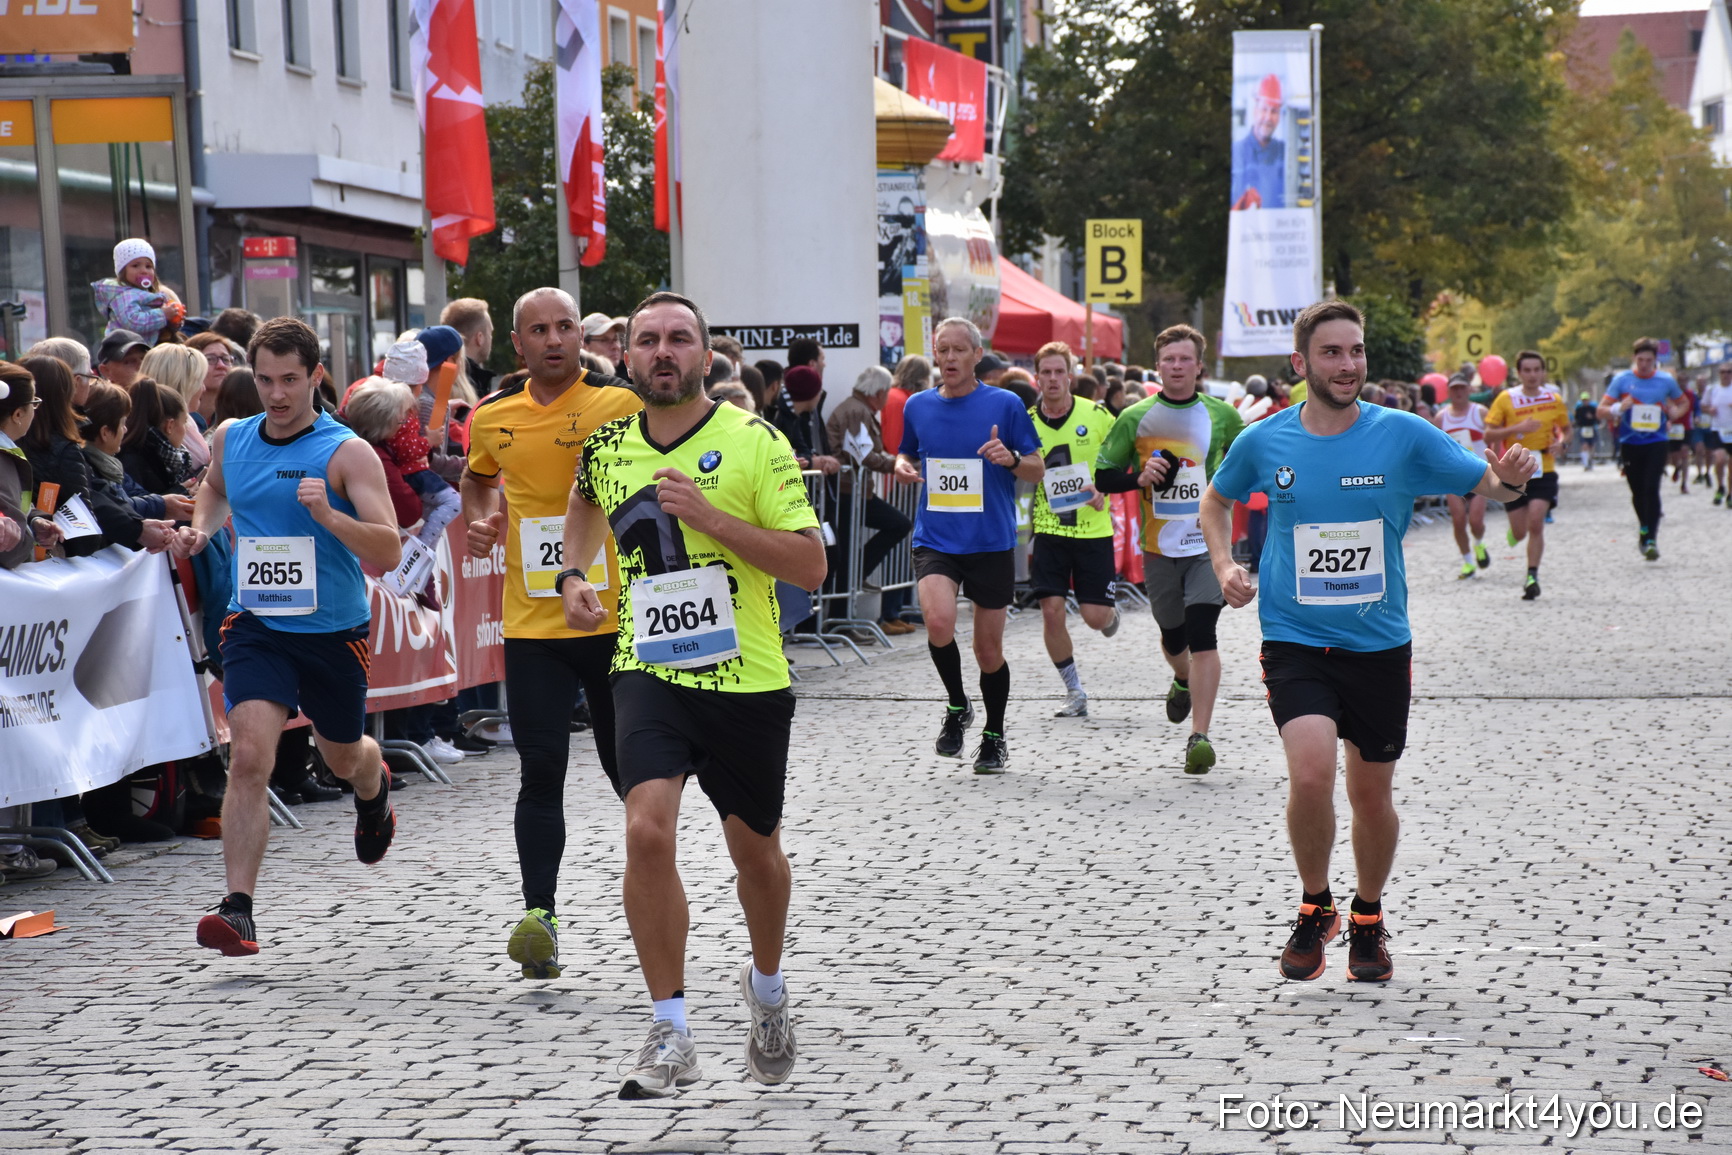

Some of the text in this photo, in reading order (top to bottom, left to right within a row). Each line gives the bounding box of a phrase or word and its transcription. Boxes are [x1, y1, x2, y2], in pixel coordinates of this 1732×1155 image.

[1093, 224, 1135, 238] Block
[1101, 246, 1127, 284] B
[1467, 334, 1482, 356] C
[498, 441, 512, 450] Alex
[276, 470, 307, 479] THULE
[694, 475, 719, 486] Partl
[1341, 476, 1384, 486] BOCK
[939, 475, 969, 491] 304
[1051, 477, 1084, 496] 2692
[1308, 546, 1372, 573] 2527
[247, 561, 303, 585] 2655
[663, 578, 698, 592] BOCK
[1324, 581, 1360, 591] Thomas
[257, 593, 292, 602] Matthias
[646, 597, 718, 637] 2664
[0, 619, 68, 677] AMICS.
[672, 641, 699, 654] Erich
